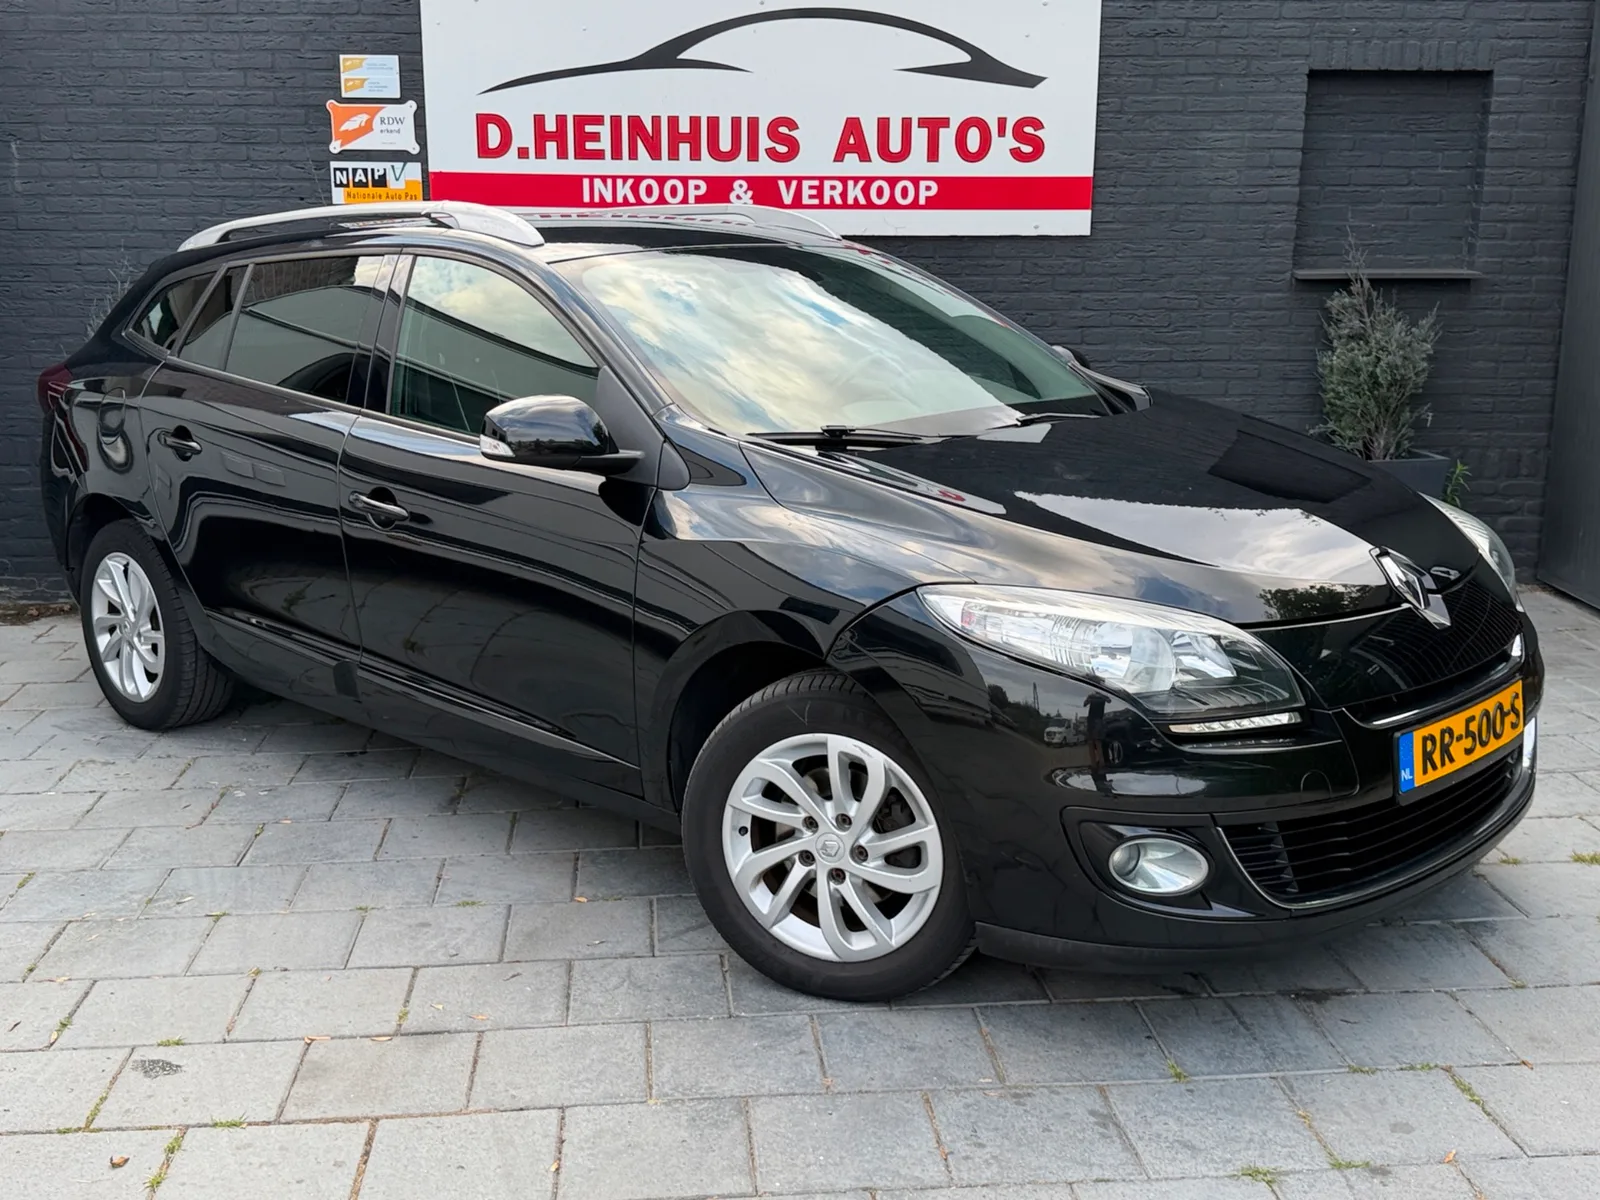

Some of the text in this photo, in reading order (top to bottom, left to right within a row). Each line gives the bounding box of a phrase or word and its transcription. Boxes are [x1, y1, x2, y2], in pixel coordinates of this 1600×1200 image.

[380, 116, 405, 126] RDW
[475, 113, 1045, 163] D.HEINHUIS AUTO'S
[346, 191, 418, 201] Nationale Auto Pas
[582, 177, 939, 206] INKOOP & VERKOOP
[1422, 691, 1520, 776] RR-500-S
[1401, 768, 1413, 782] NL
